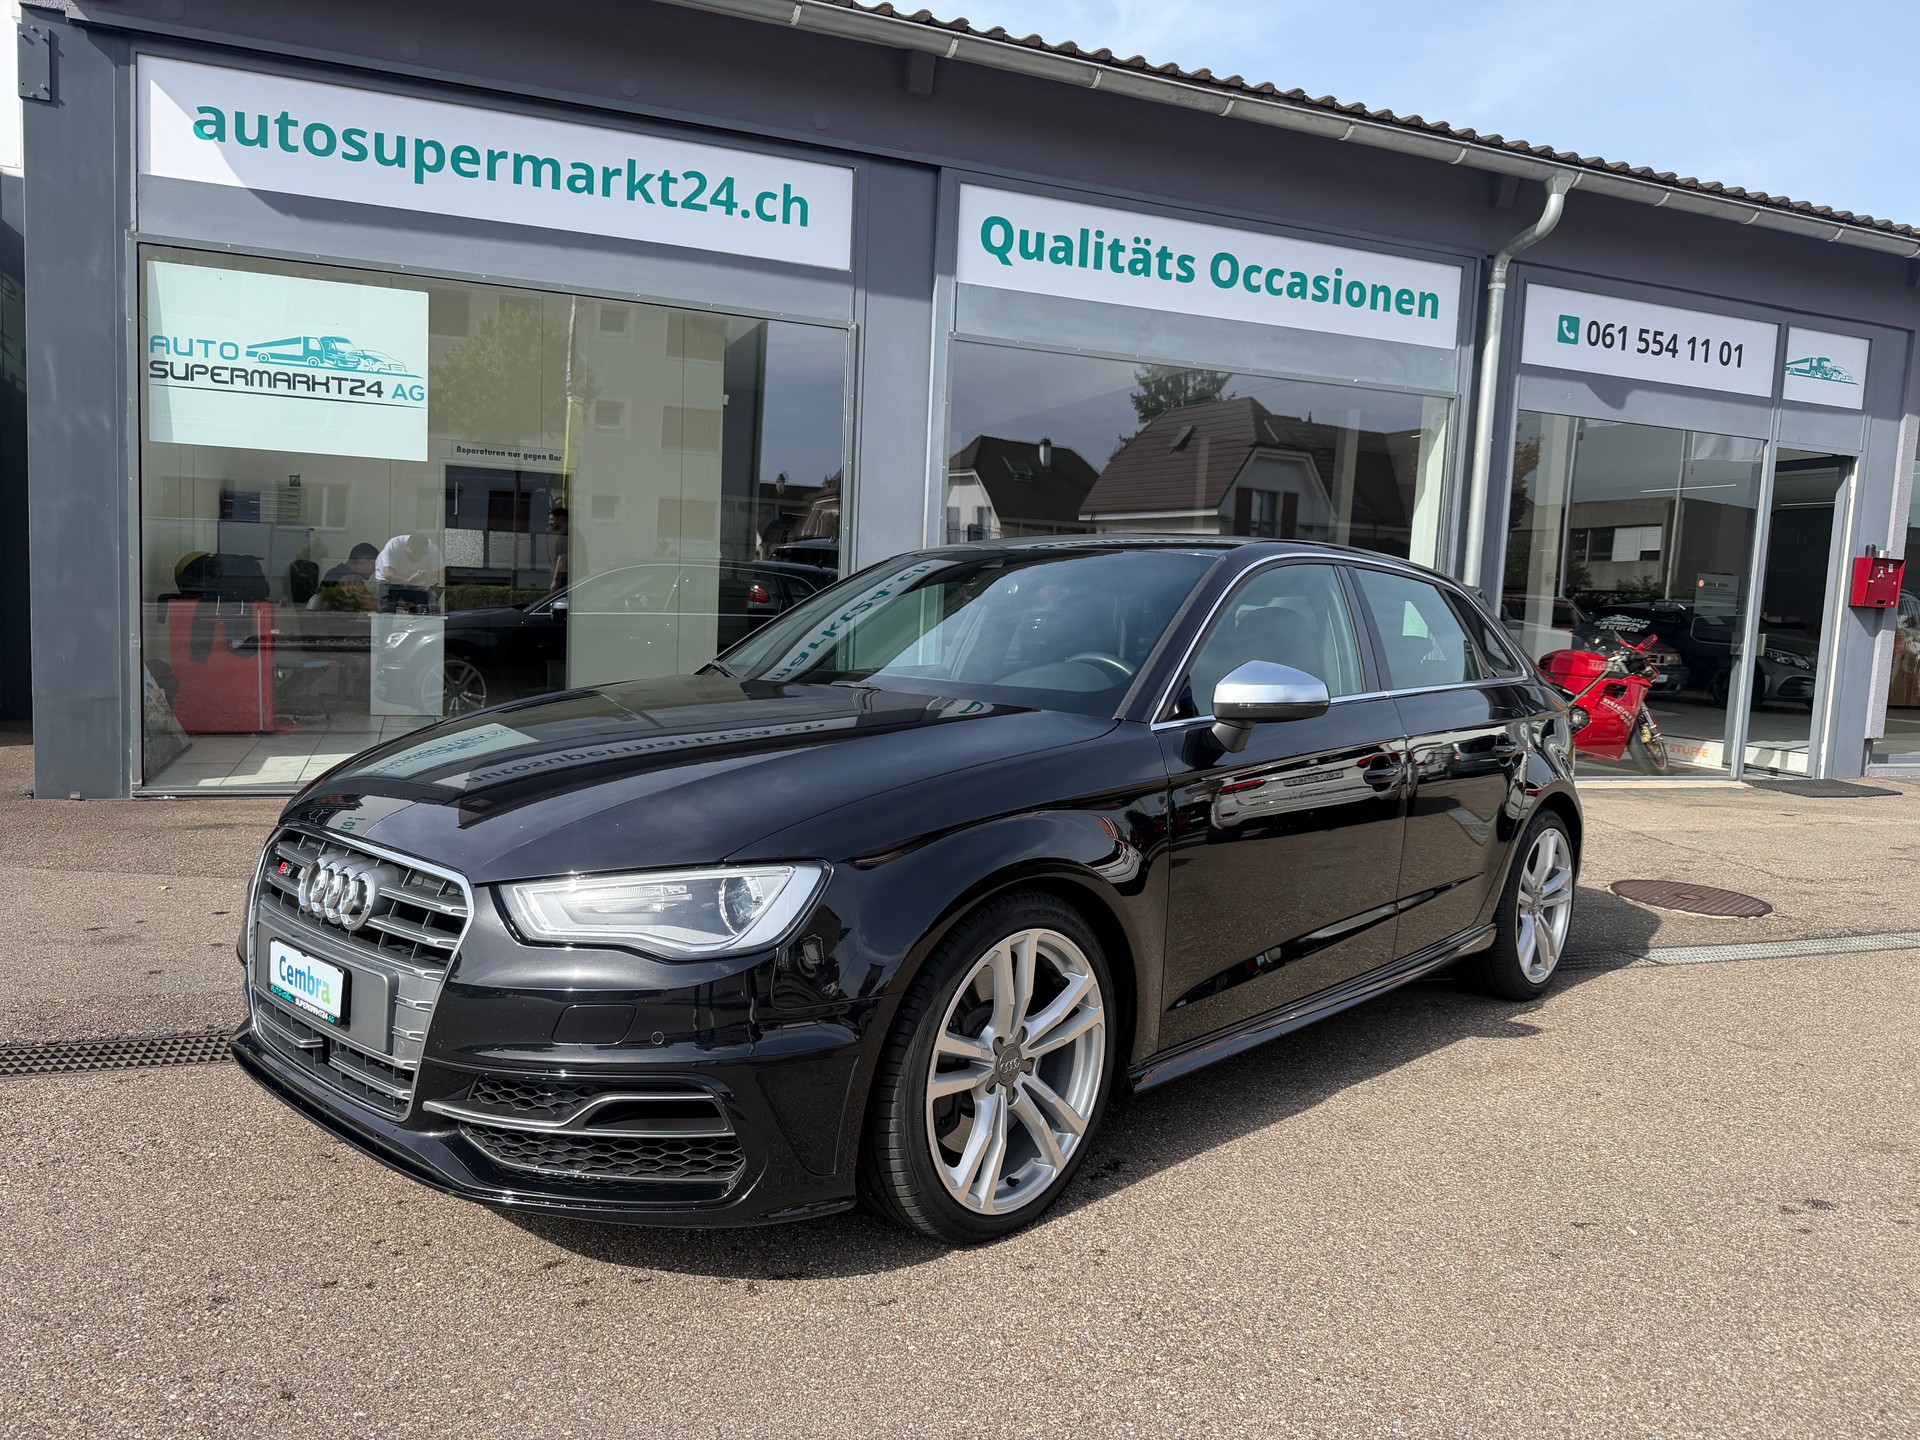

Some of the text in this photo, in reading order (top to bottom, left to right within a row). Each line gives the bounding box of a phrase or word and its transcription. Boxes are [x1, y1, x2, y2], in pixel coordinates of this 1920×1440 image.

[193, 105, 810, 228] autosupermarkt24.ch
[980, 216, 1440, 319] Qualitäts Occasionen
[149, 335, 239, 361] AUTO
[1586, 320, 1744, 368] 061 554 11 01
[149, 360, 425, 401] SUPERMARKT24 AG
[456, 446, 505, 456] Reparaturen
[523, 453, 547, 461] gegen
[1669, 743, 1709, 758] STUFFE
[279, 955, 330, 1004] Cembra
